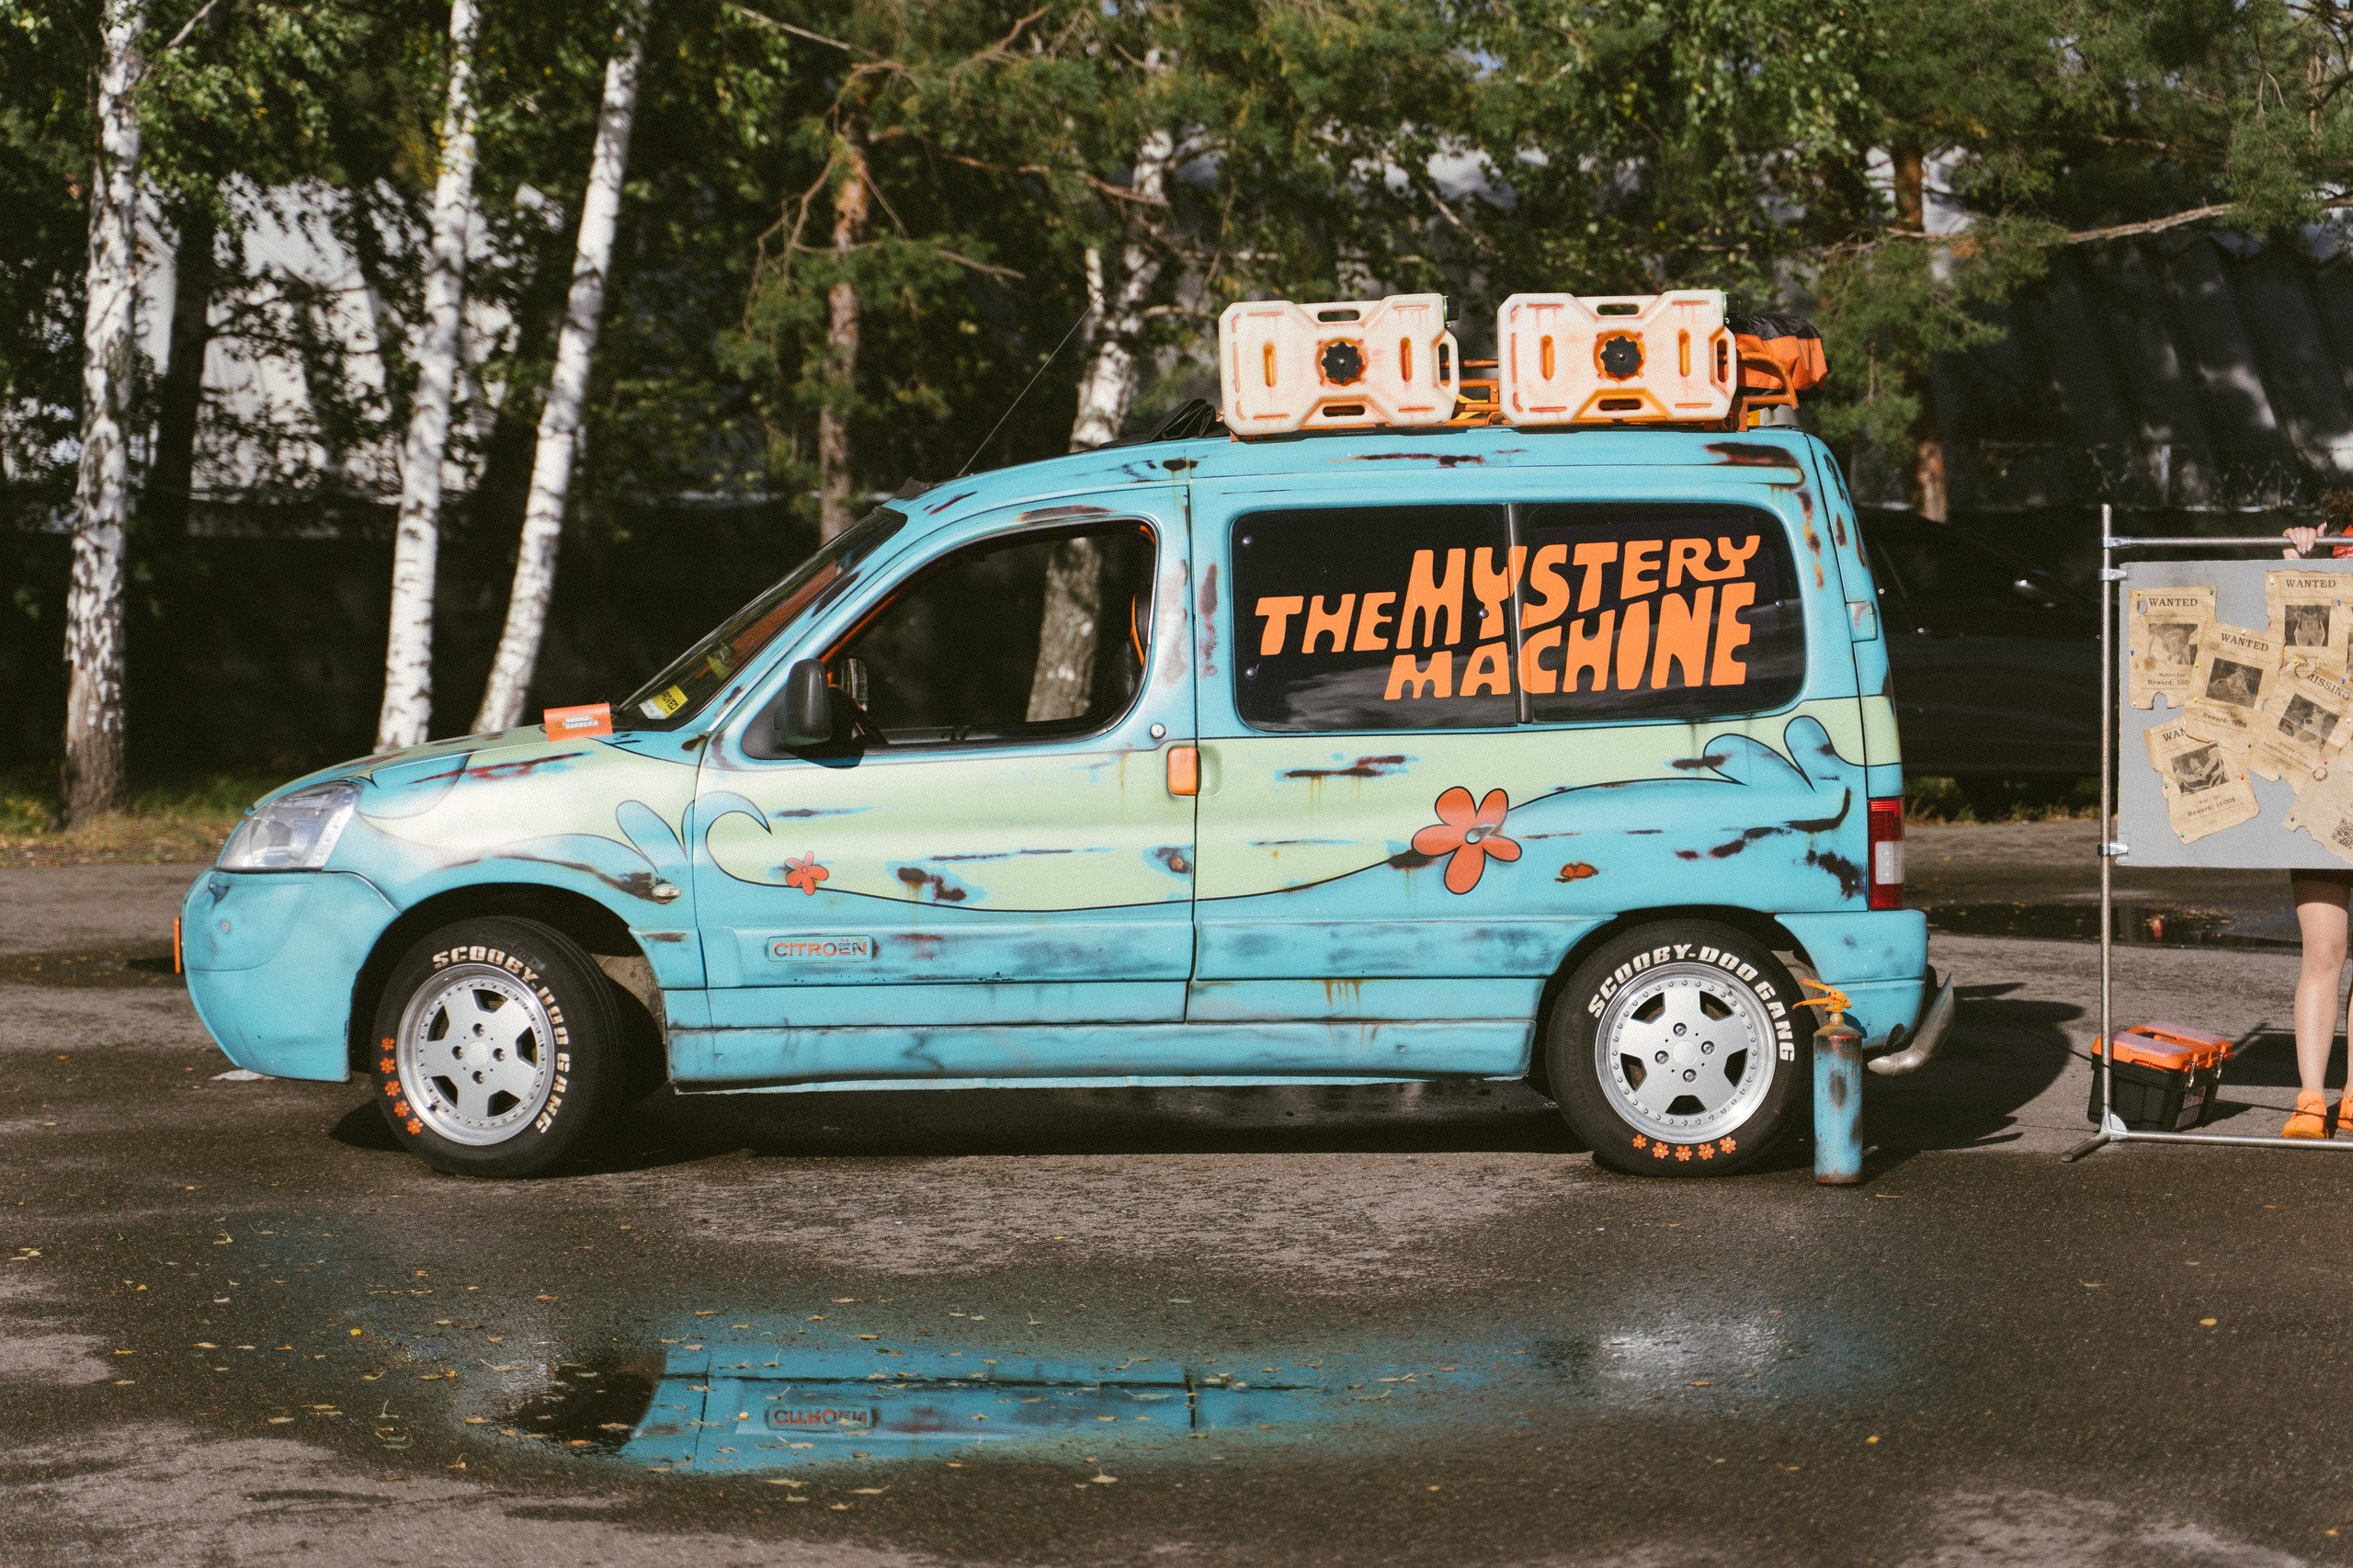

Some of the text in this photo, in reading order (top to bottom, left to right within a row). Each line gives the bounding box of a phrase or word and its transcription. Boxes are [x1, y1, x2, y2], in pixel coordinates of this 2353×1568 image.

[1255, 535, 1761, 655] THE MYSTERY
[2285, 579, 2336, 588] WANTED
[2148, 597, 2198, 607] WANTED
[1383, 582, 1756, 700] MACHINE
[2221, 632, 2269, 652] WANTED
[2307, 673, 2350, 700] MISSING
[1754, 981, 1795, 1062] GANG
